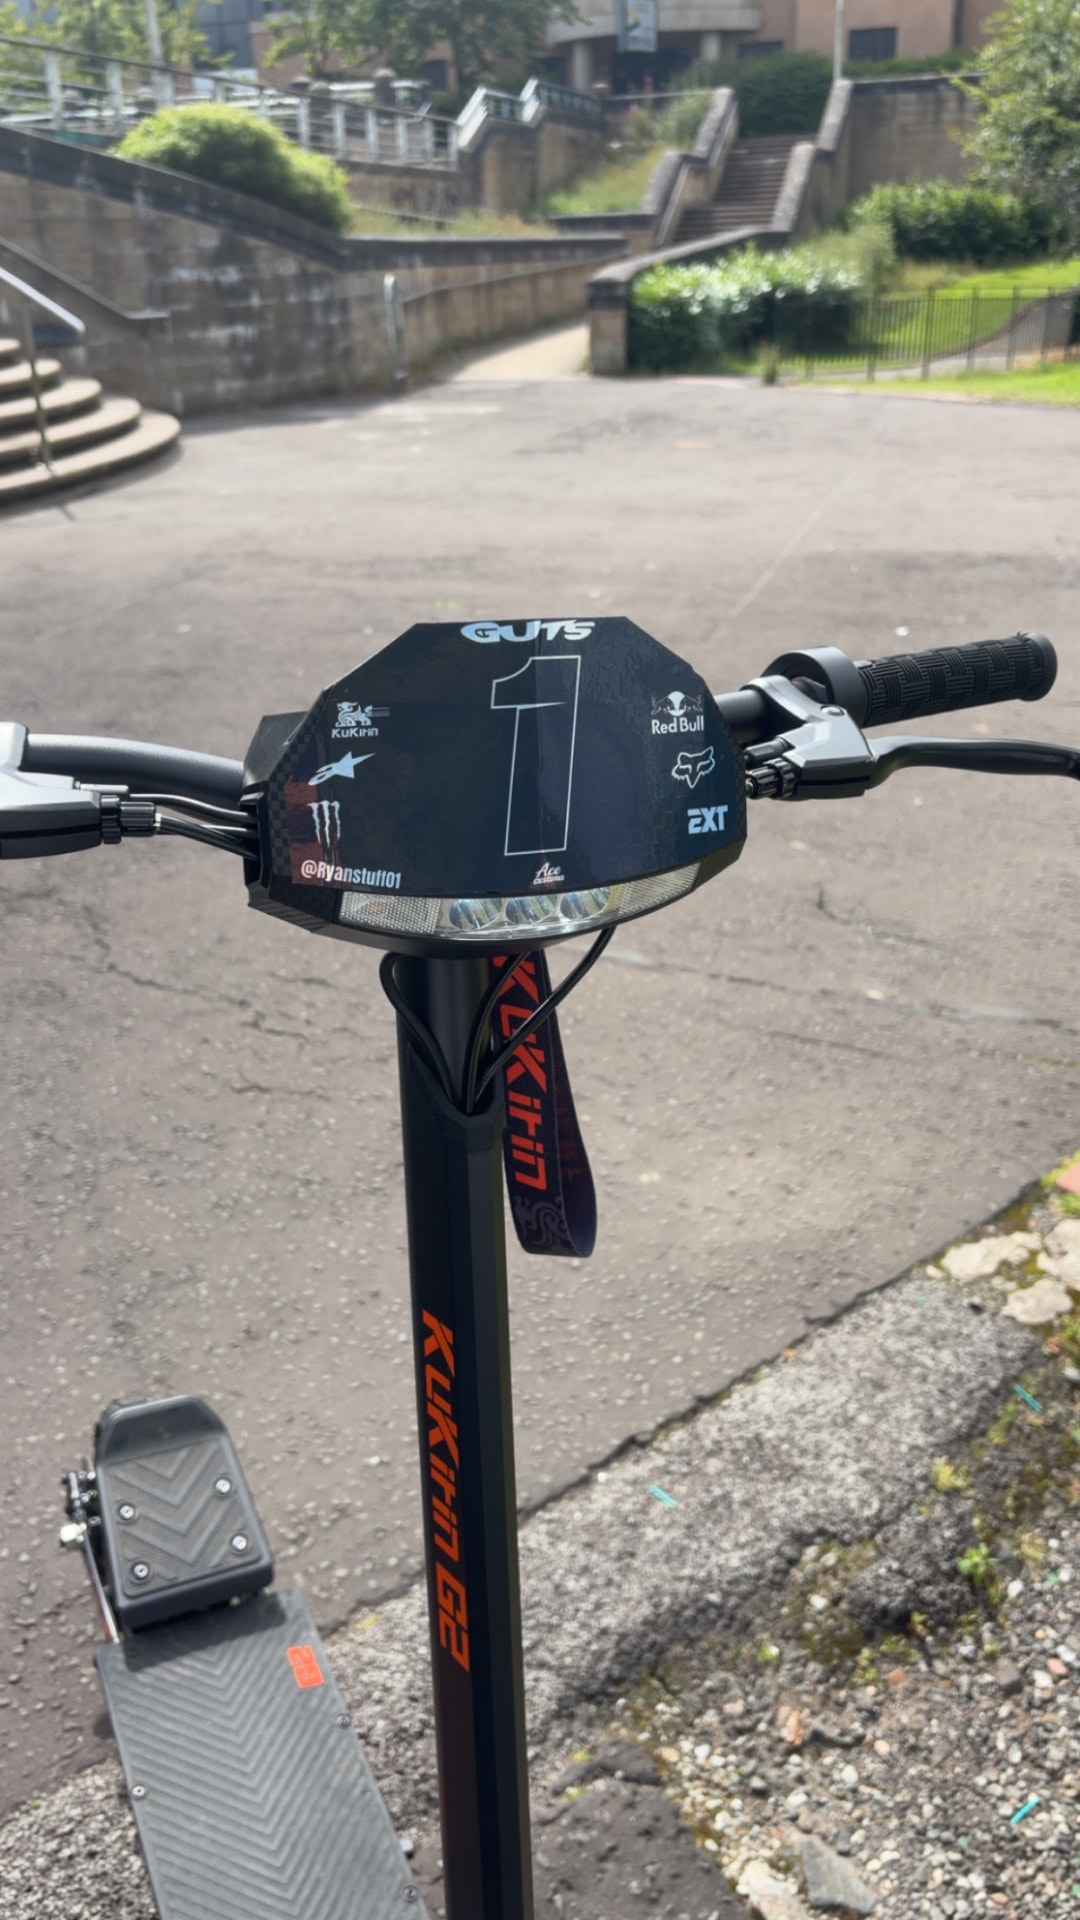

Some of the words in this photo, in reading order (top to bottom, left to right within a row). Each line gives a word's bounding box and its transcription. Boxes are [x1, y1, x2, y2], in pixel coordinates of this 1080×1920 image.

[460, 619, 596, 643] GUTS
[651, 716, 677, 735] Red
[679, 715, 704, 732] Bull
[490, 654, 581, 857] 1
[687, 804, 729, 835] EXT
[300, 859, 402, 889] @Ryanstuff01
[535, 861, 562, 879] Ace
[422, 1309, 459, 1562] KuKirin
[435, 1561, 470, 1672] G2
